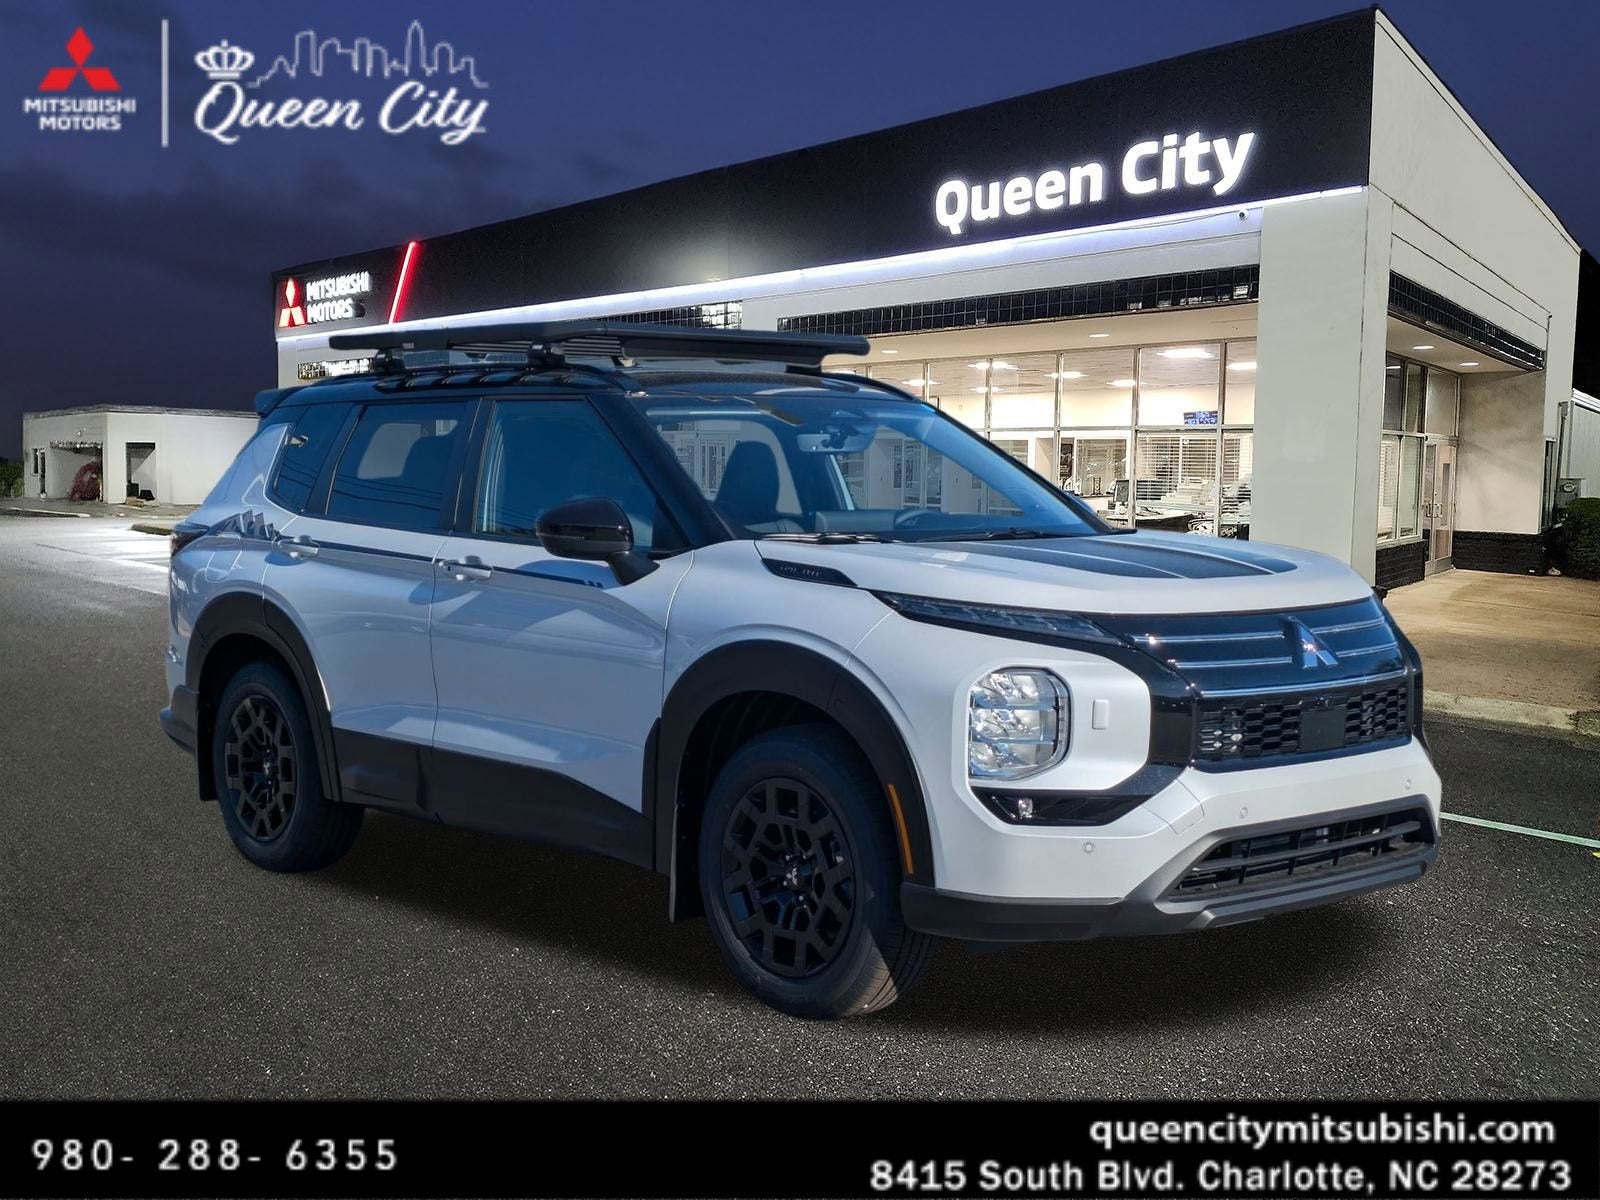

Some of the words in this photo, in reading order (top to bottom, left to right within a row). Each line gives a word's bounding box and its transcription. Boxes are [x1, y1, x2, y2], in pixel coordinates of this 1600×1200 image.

[935, 161, 1104, 235] Queen
[1122, 131, 1255, 196] City
[306, 271, 370, 301] MITSUBISHI
[307, 298, 354, 323] MOTORS
